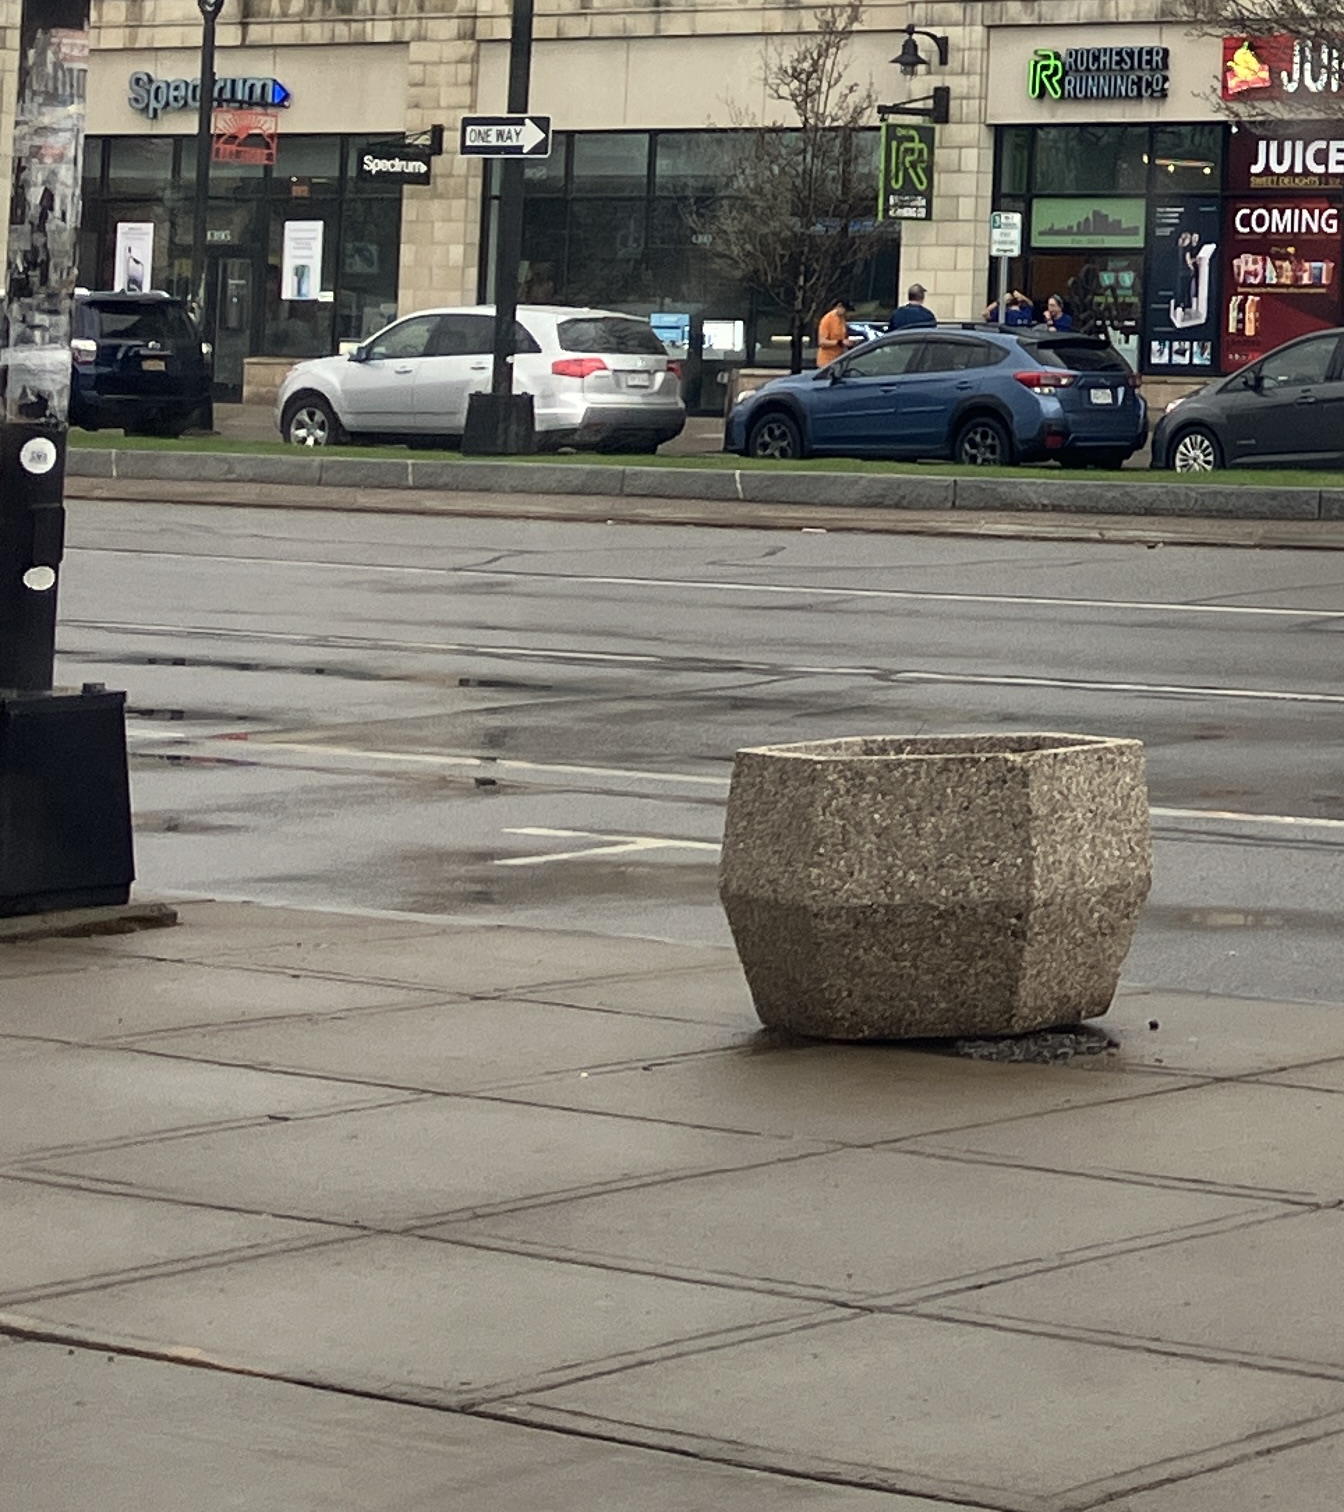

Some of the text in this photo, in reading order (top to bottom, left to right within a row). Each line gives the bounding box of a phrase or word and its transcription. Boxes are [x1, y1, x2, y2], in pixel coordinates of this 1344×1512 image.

[1065, 46, 1165, 72] ROCHESTER
[128, 71, 275, 120] Specrum
[1064, 74, 1139, 99] RUNNING
[469, 129, 523, 144] ONE WAY
[363, 155, 422, 175] Spectrum
[1235, 208, 1339, 234] COMING
